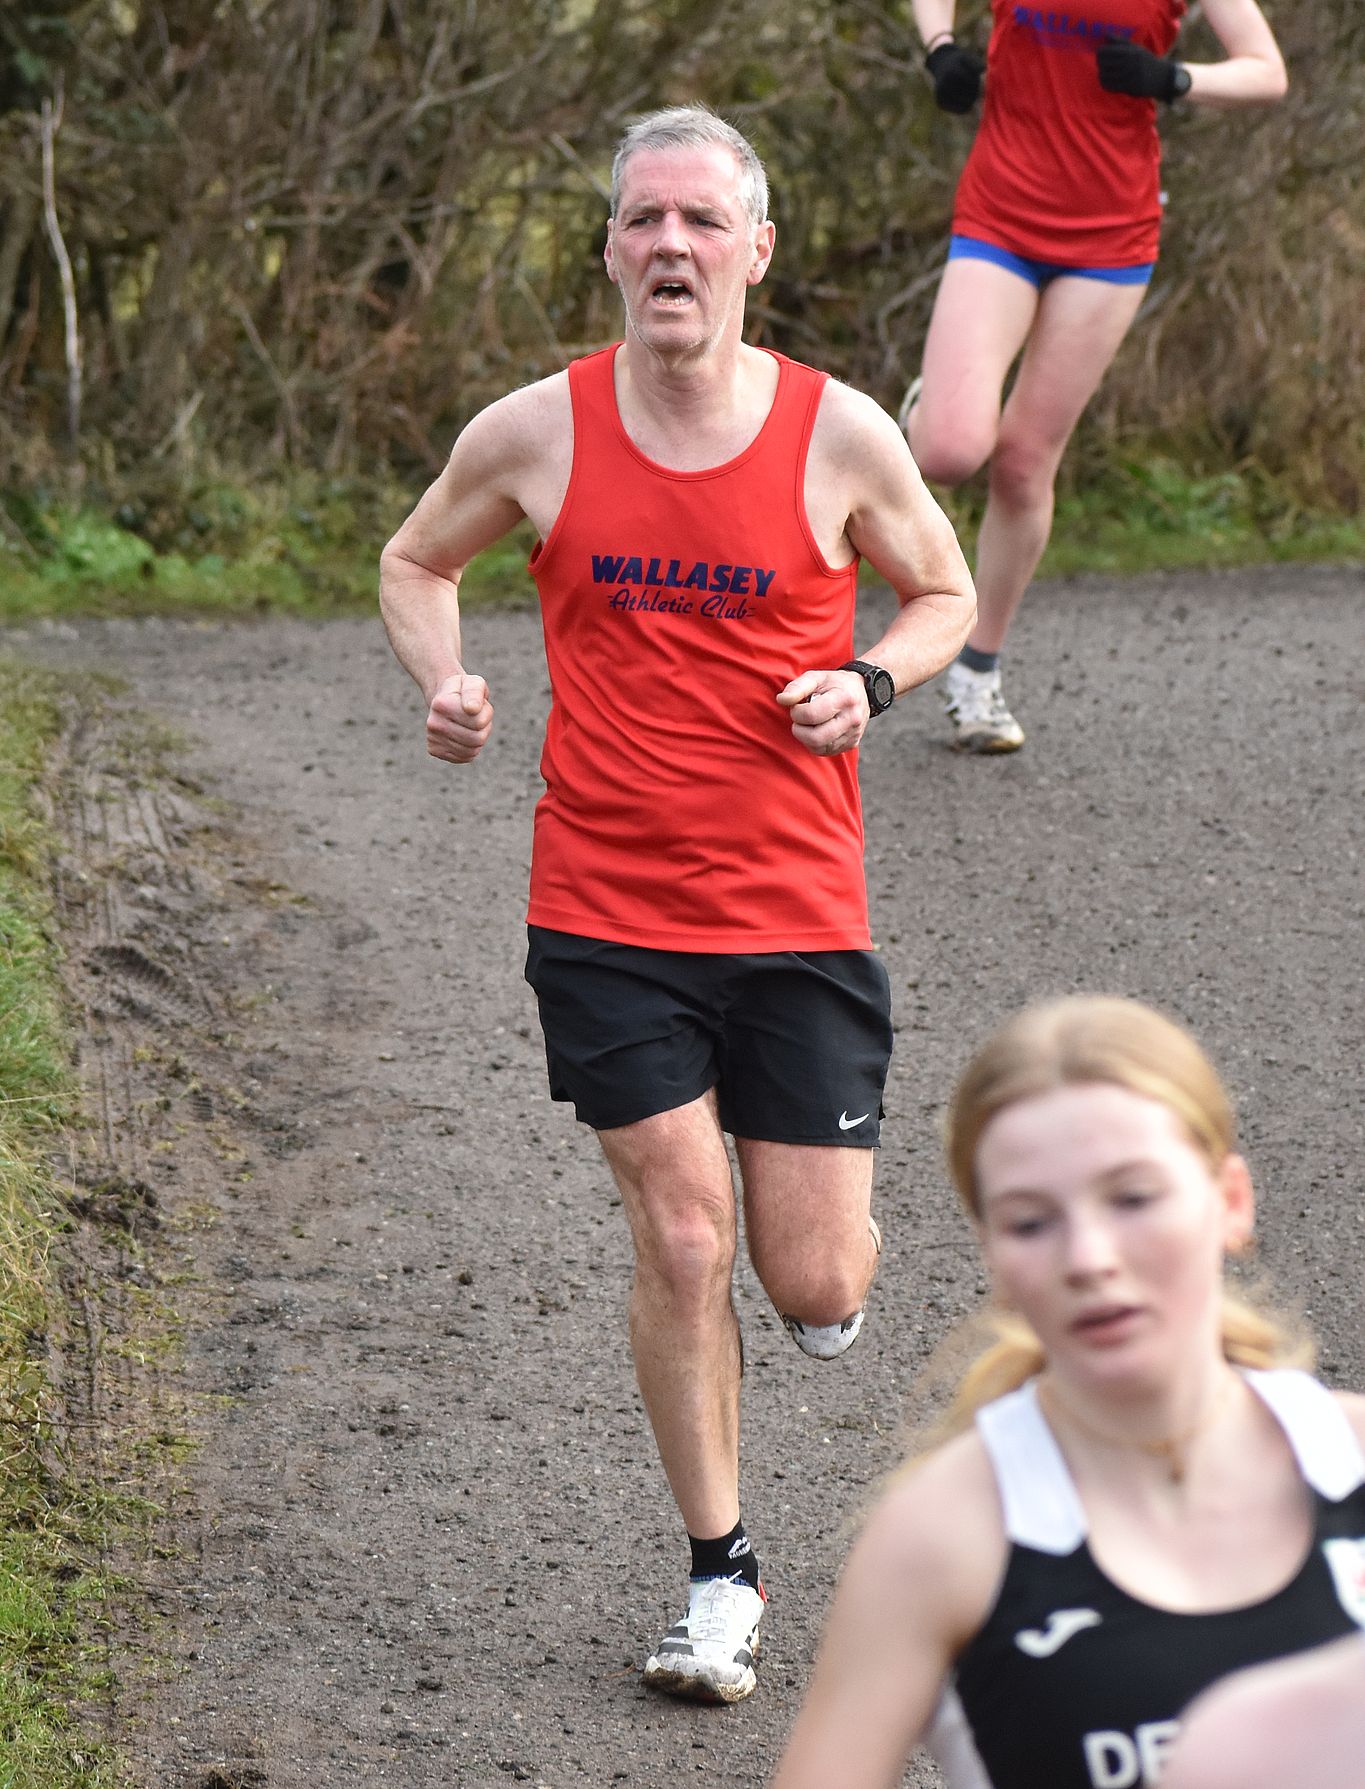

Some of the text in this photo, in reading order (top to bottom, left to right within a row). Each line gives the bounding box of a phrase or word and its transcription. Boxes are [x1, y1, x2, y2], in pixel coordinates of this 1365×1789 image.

[591, 555, 776, 597] WALLASEY
[610, 588, 750, 619] Athletic Club
